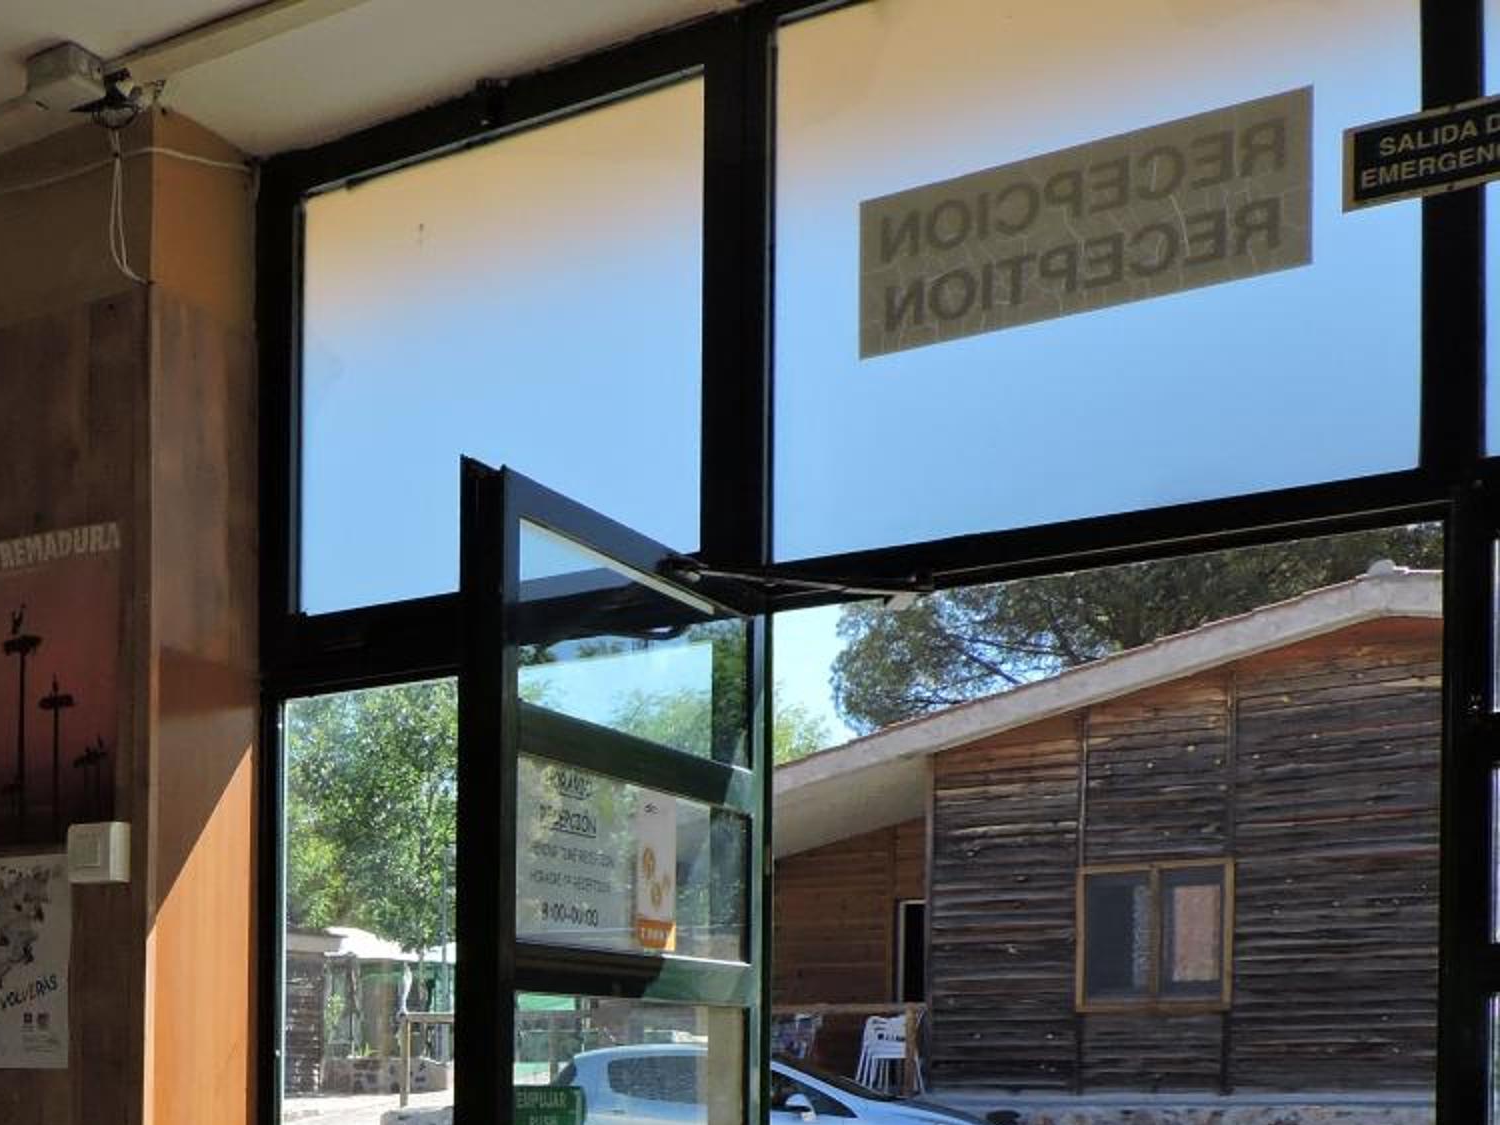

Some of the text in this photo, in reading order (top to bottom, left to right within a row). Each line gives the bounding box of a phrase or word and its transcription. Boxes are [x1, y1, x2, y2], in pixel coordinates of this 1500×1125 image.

[1379, 119, 1478, 157] SALIDA
[1361, 142, 1500, 190] EMERGEN
[516, 1090, 567, 1110] EMPUJAR
